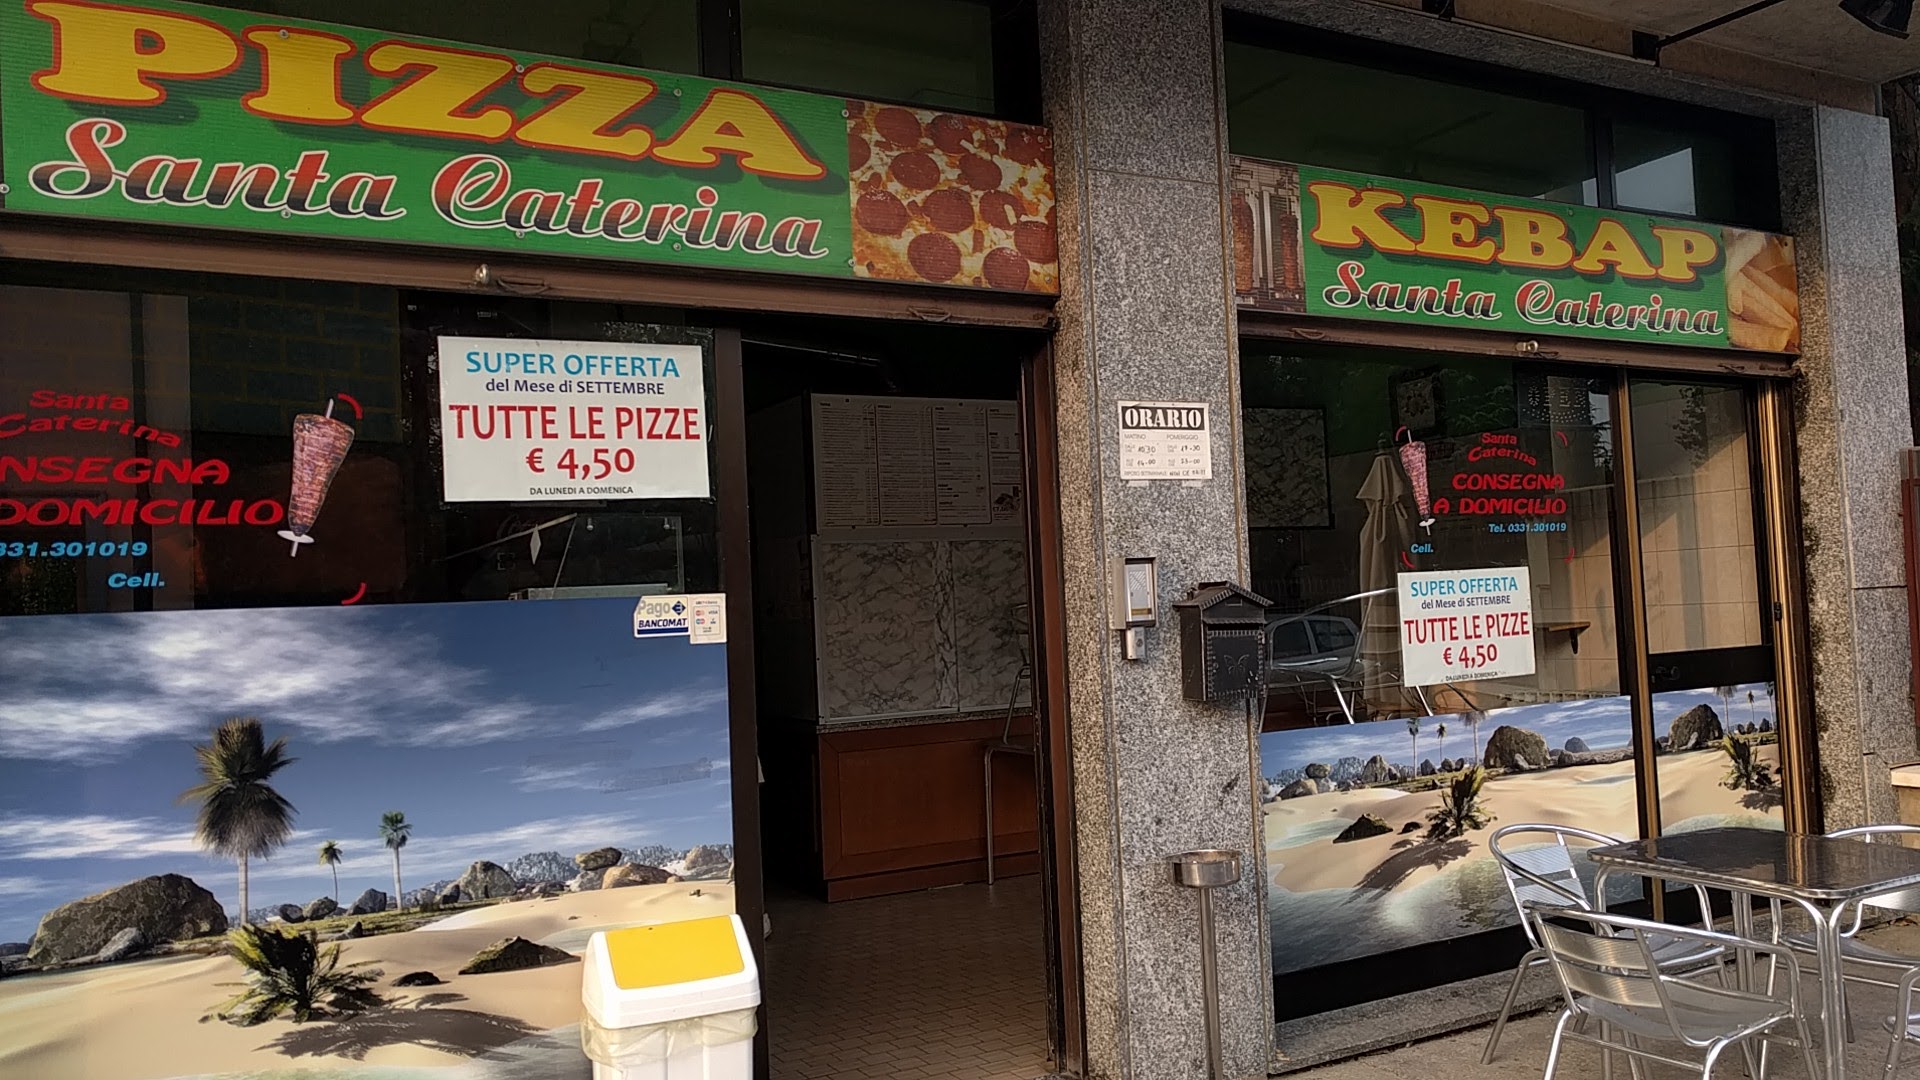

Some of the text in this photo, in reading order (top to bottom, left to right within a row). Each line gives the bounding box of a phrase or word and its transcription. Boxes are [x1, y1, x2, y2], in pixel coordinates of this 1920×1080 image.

[24, 0, 826, 180] PIZZA
[29, 118, 829, 258] Santa Caterina
[1308, 180, 1718, 283] KEBAP
[1322, 260, 1724, 335] Santa Caterina
[466, 351, 680, 378] SUPER OFFERTA
[486, 379, 664, 395] del Mese di SETTEMBRE
[30, 390, 129, 411] Santa
[449, 405, 700, 440] TUTTE LE PIZZE
[1125, 408, 1201, 428] ORARIO
[0, 413, 181, 448] Caterina
[1482, 432, 1518, 444] Santa
[526, 448, 635, 480] € 4,50
[1467, 446, 1537, 467] Caterina
[530, 487, 543, 495] DA
[545, 487, 577, 495] LUNEDI
[586, 486, 634, 495] DOMENICA
[1452, 473, 1565, 490] CONSEGNA
[1433, 497, 1567, 515] A DOMICILIO
[1488, 522, 1567, 533] Tel. 0331.301019
[1411, 544, 1434, 553] Cell.
[108, 573, 165, 588] Cell.
[1410, 576, 1518, 597] SUPER OFFERTA
[638, 600, 670, 617] Pago
[1421, 595, 1511, 609] del Mese di SETTEMBRE
[638, 618, 687, 628] BANCOMAT
[1404, 612, 1530, 644] TUTTE LE PIZZE
[1443, 644, 1497, 669] € 4,50
